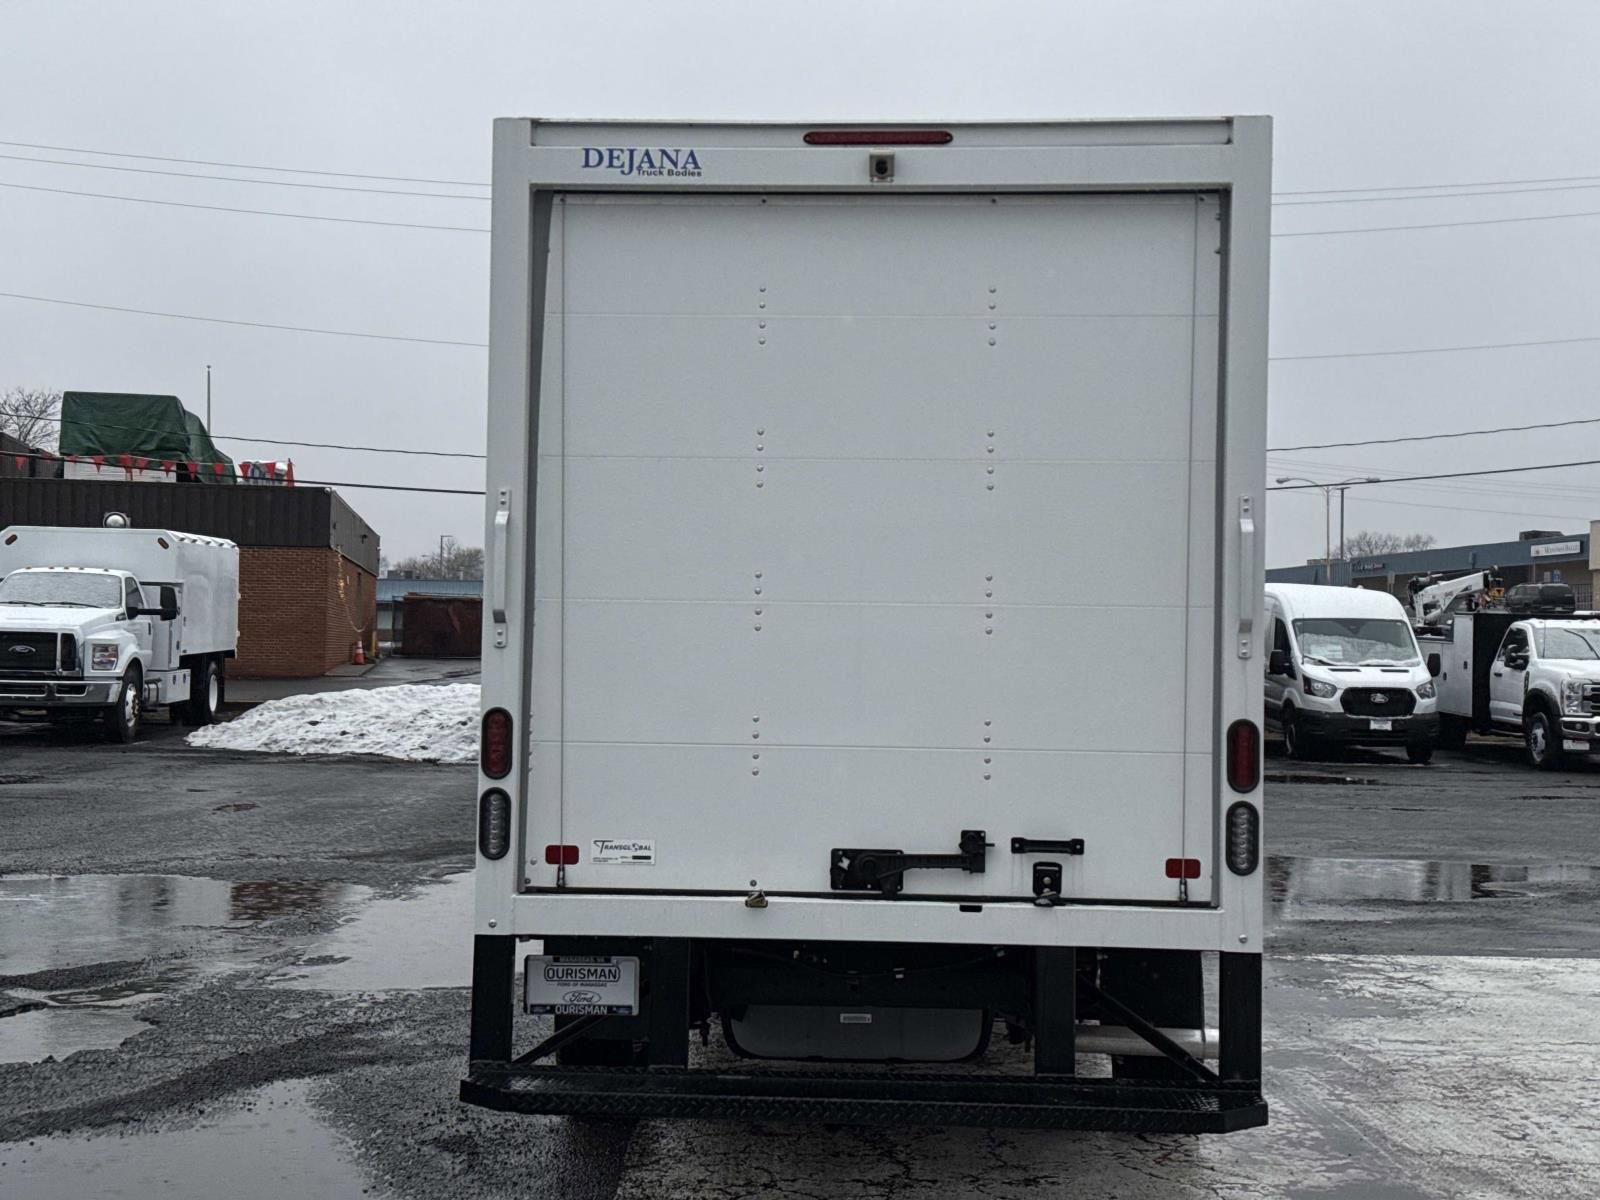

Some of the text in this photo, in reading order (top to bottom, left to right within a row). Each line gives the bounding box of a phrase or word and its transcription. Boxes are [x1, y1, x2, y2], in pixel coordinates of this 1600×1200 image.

[581, 147, 702, 176] DEJANA
[637, 168, 702, 177] Truck Bodies
[546, 967, 617, 980] OURISMAN
[555, 1004, 608, 1016] OURISMAN
